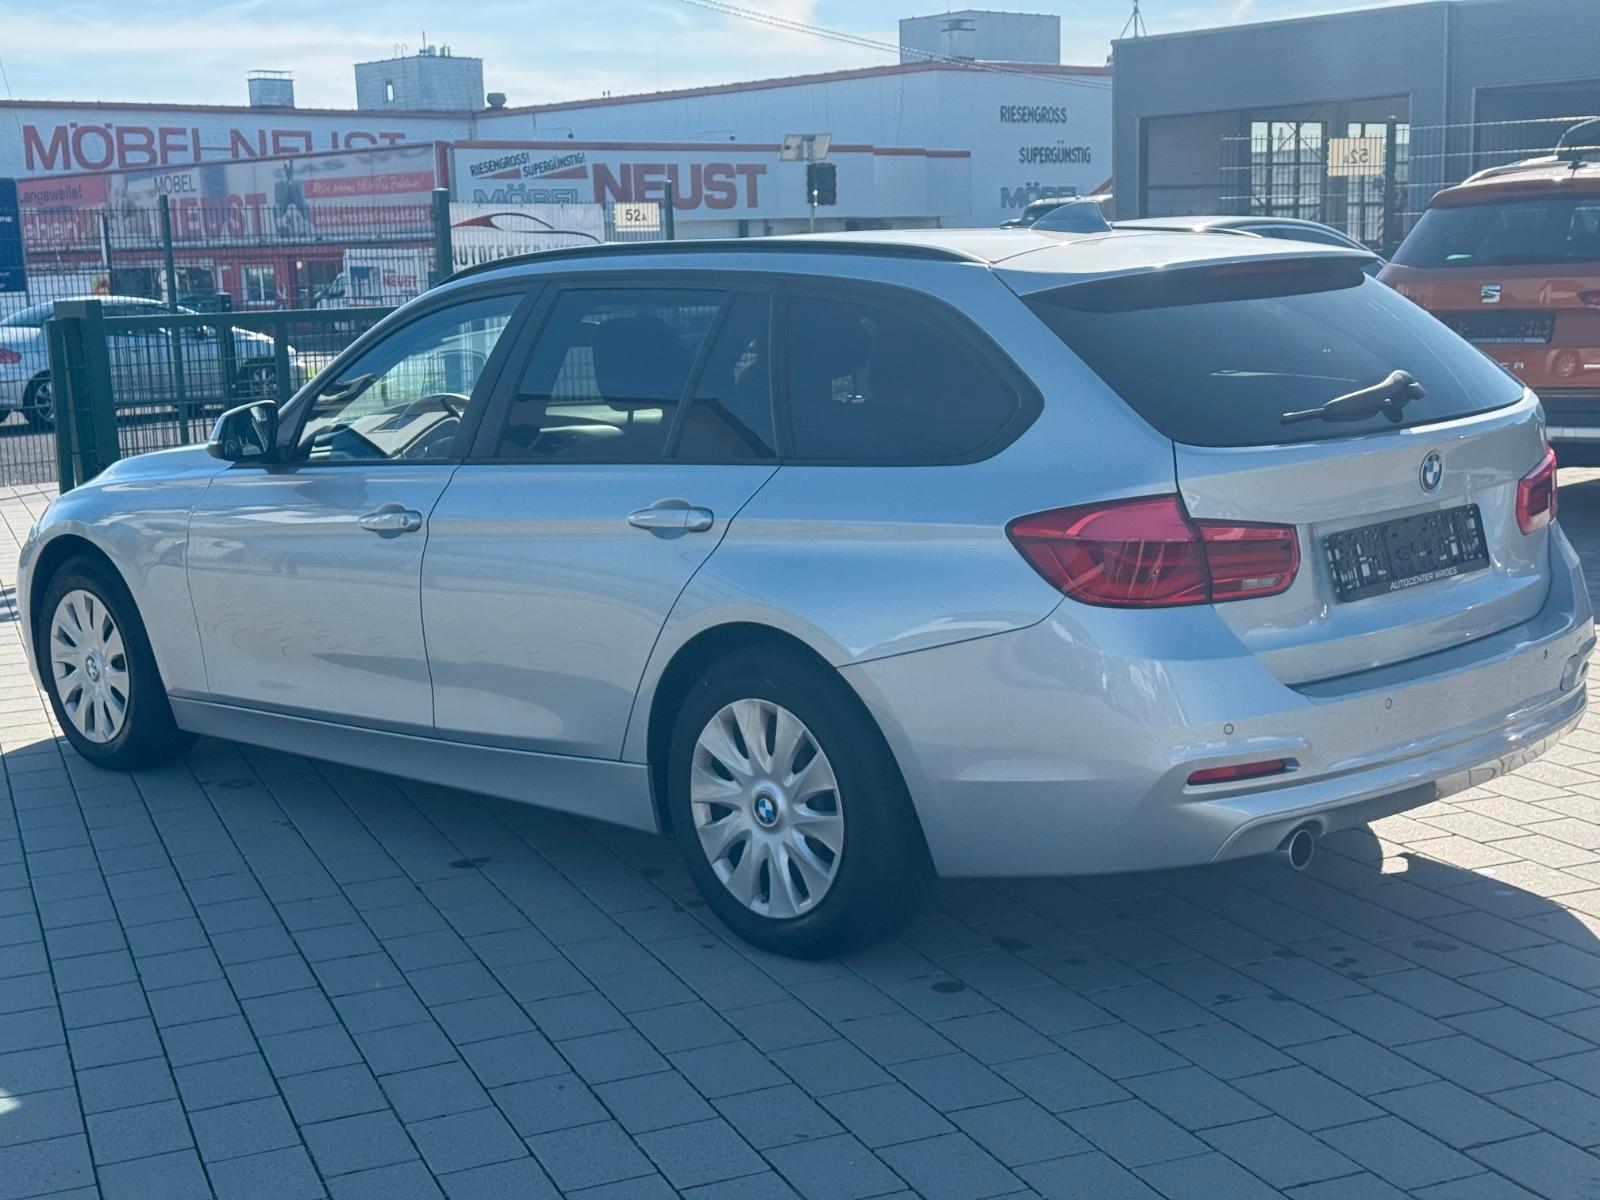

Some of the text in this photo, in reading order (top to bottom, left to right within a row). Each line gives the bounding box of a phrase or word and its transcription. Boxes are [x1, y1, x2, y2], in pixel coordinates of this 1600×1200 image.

[1000, 105, 1067, 123] RIESENGROSS
[1018, 140, 1091, 164] SUPERGÜNSTIG
[470, 152, 586, 178] RIESENGROSS! SUPERGÜNSTIG!
[20, 184, 83, 205] angeweile!
[592, 162, 767, 210] NEUST
[625, 208, 648, 222] 52A
[1390, 571, 1434, 590] AUTOCENTER
